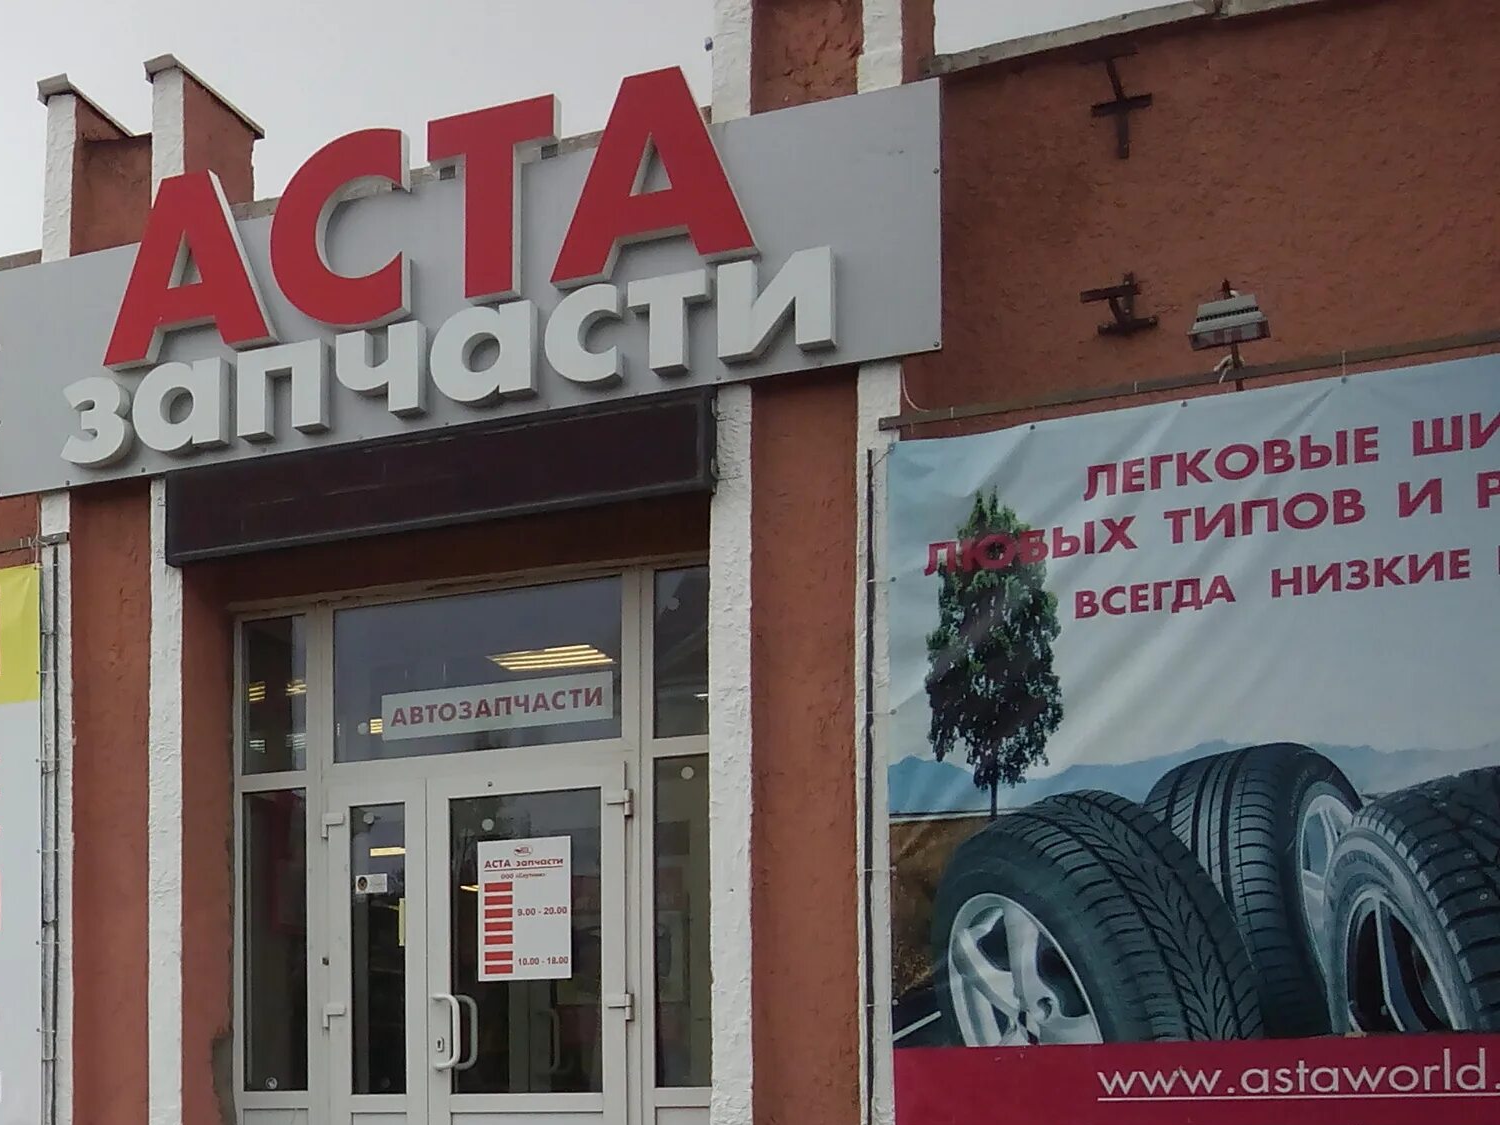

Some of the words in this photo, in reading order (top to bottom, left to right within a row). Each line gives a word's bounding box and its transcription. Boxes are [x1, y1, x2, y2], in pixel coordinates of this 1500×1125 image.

[103, 65, 760, 370] АСТА
[60, 245, 837, 468] запчасти
[1083, 425, 1379, 501] ЛЕГКОВЫЕ
[924, 515, 1138, 577] ЛЮБЫХ
[1163, 488, 1366, 544] ТИПОВ
[1399, 478, 1442, 518] И
[1074, 575, 1236, 620] ВСЕГДА
[1271, 548, 1471, 598] НИЗКИЕ
[390, 686, 603, 728] АВТОЗАПЧАСТИ
[484, 860, 511, 869] АСТА
[516, 859, 564, 867] запчасти
